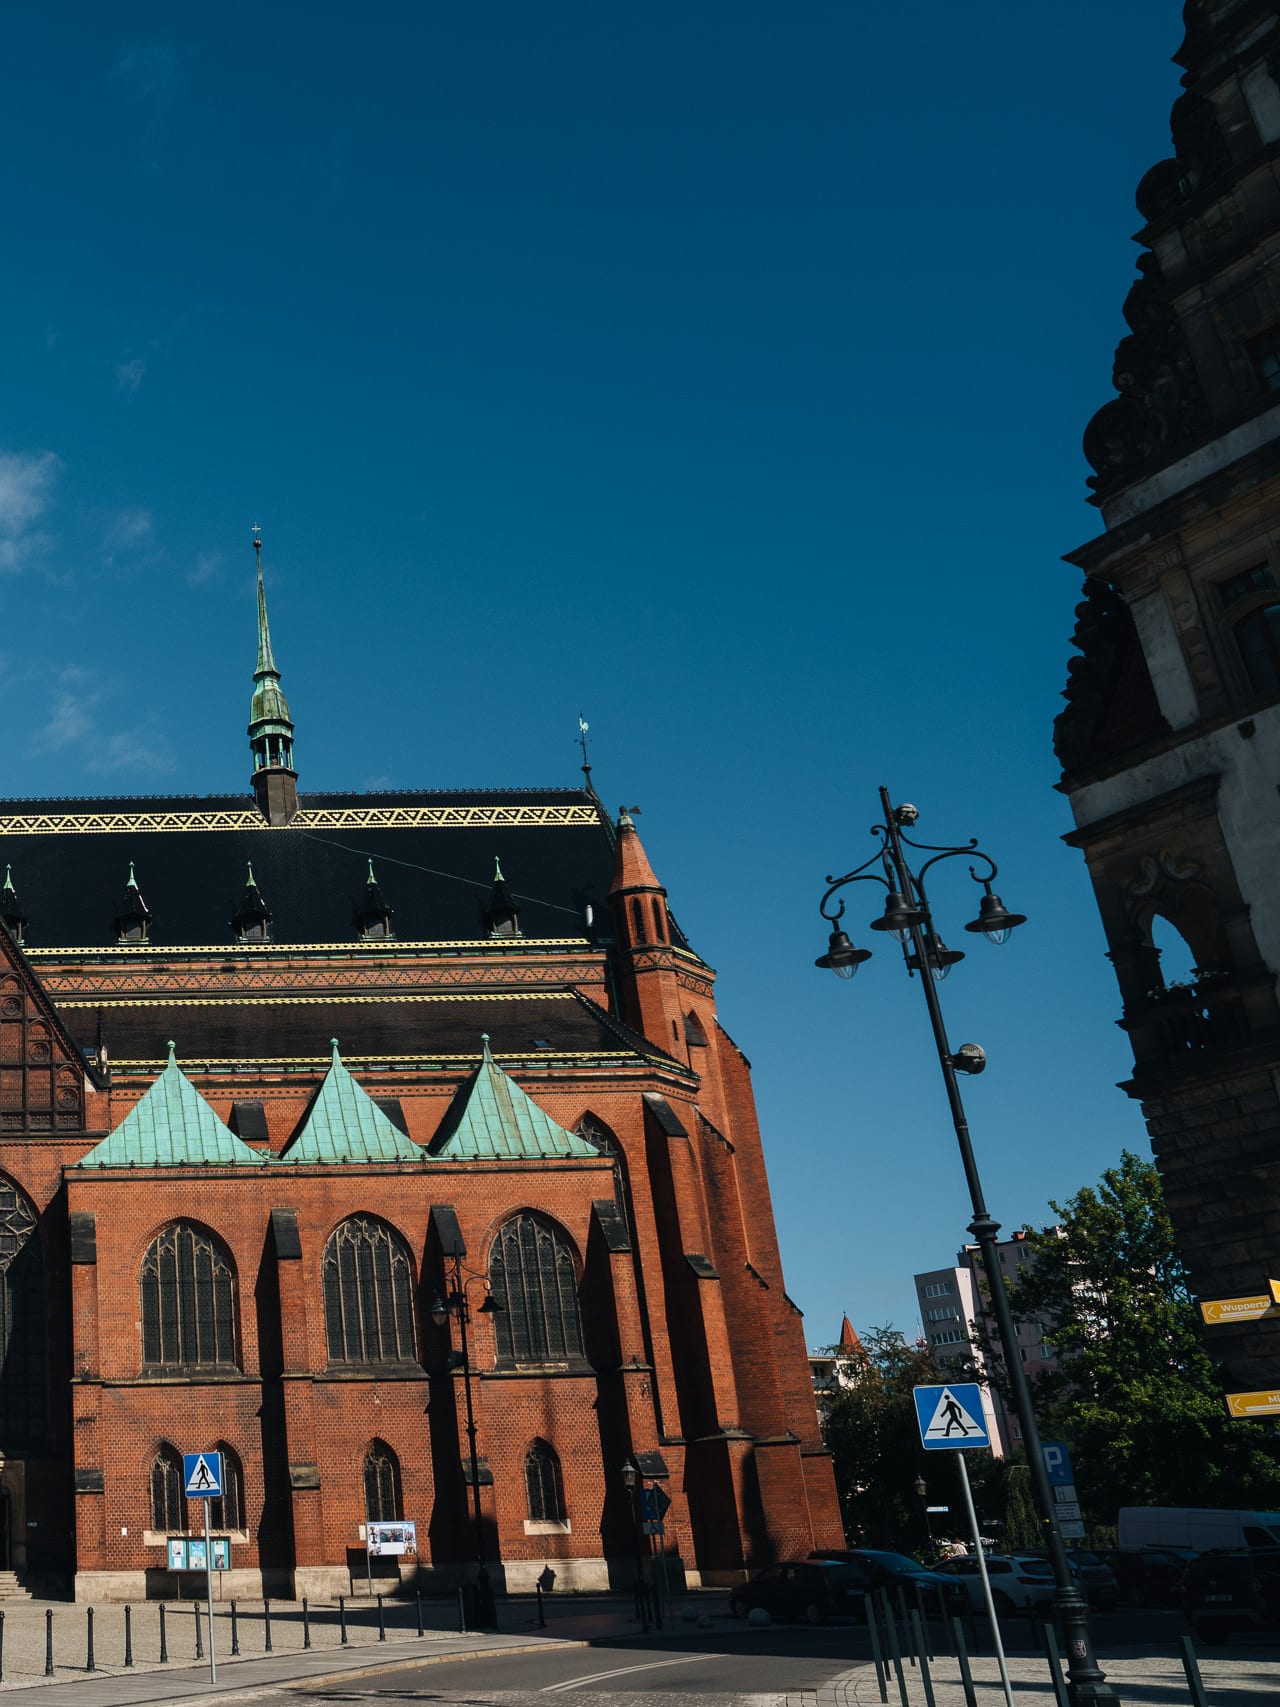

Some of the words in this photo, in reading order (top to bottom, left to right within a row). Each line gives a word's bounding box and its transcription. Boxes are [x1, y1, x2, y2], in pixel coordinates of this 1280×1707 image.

[1220, 1299, 1271, 1312] Wuppertal
[1267, 1394, 1280, 1403] Mi
[1042, 1446, 1063, 1473] P
